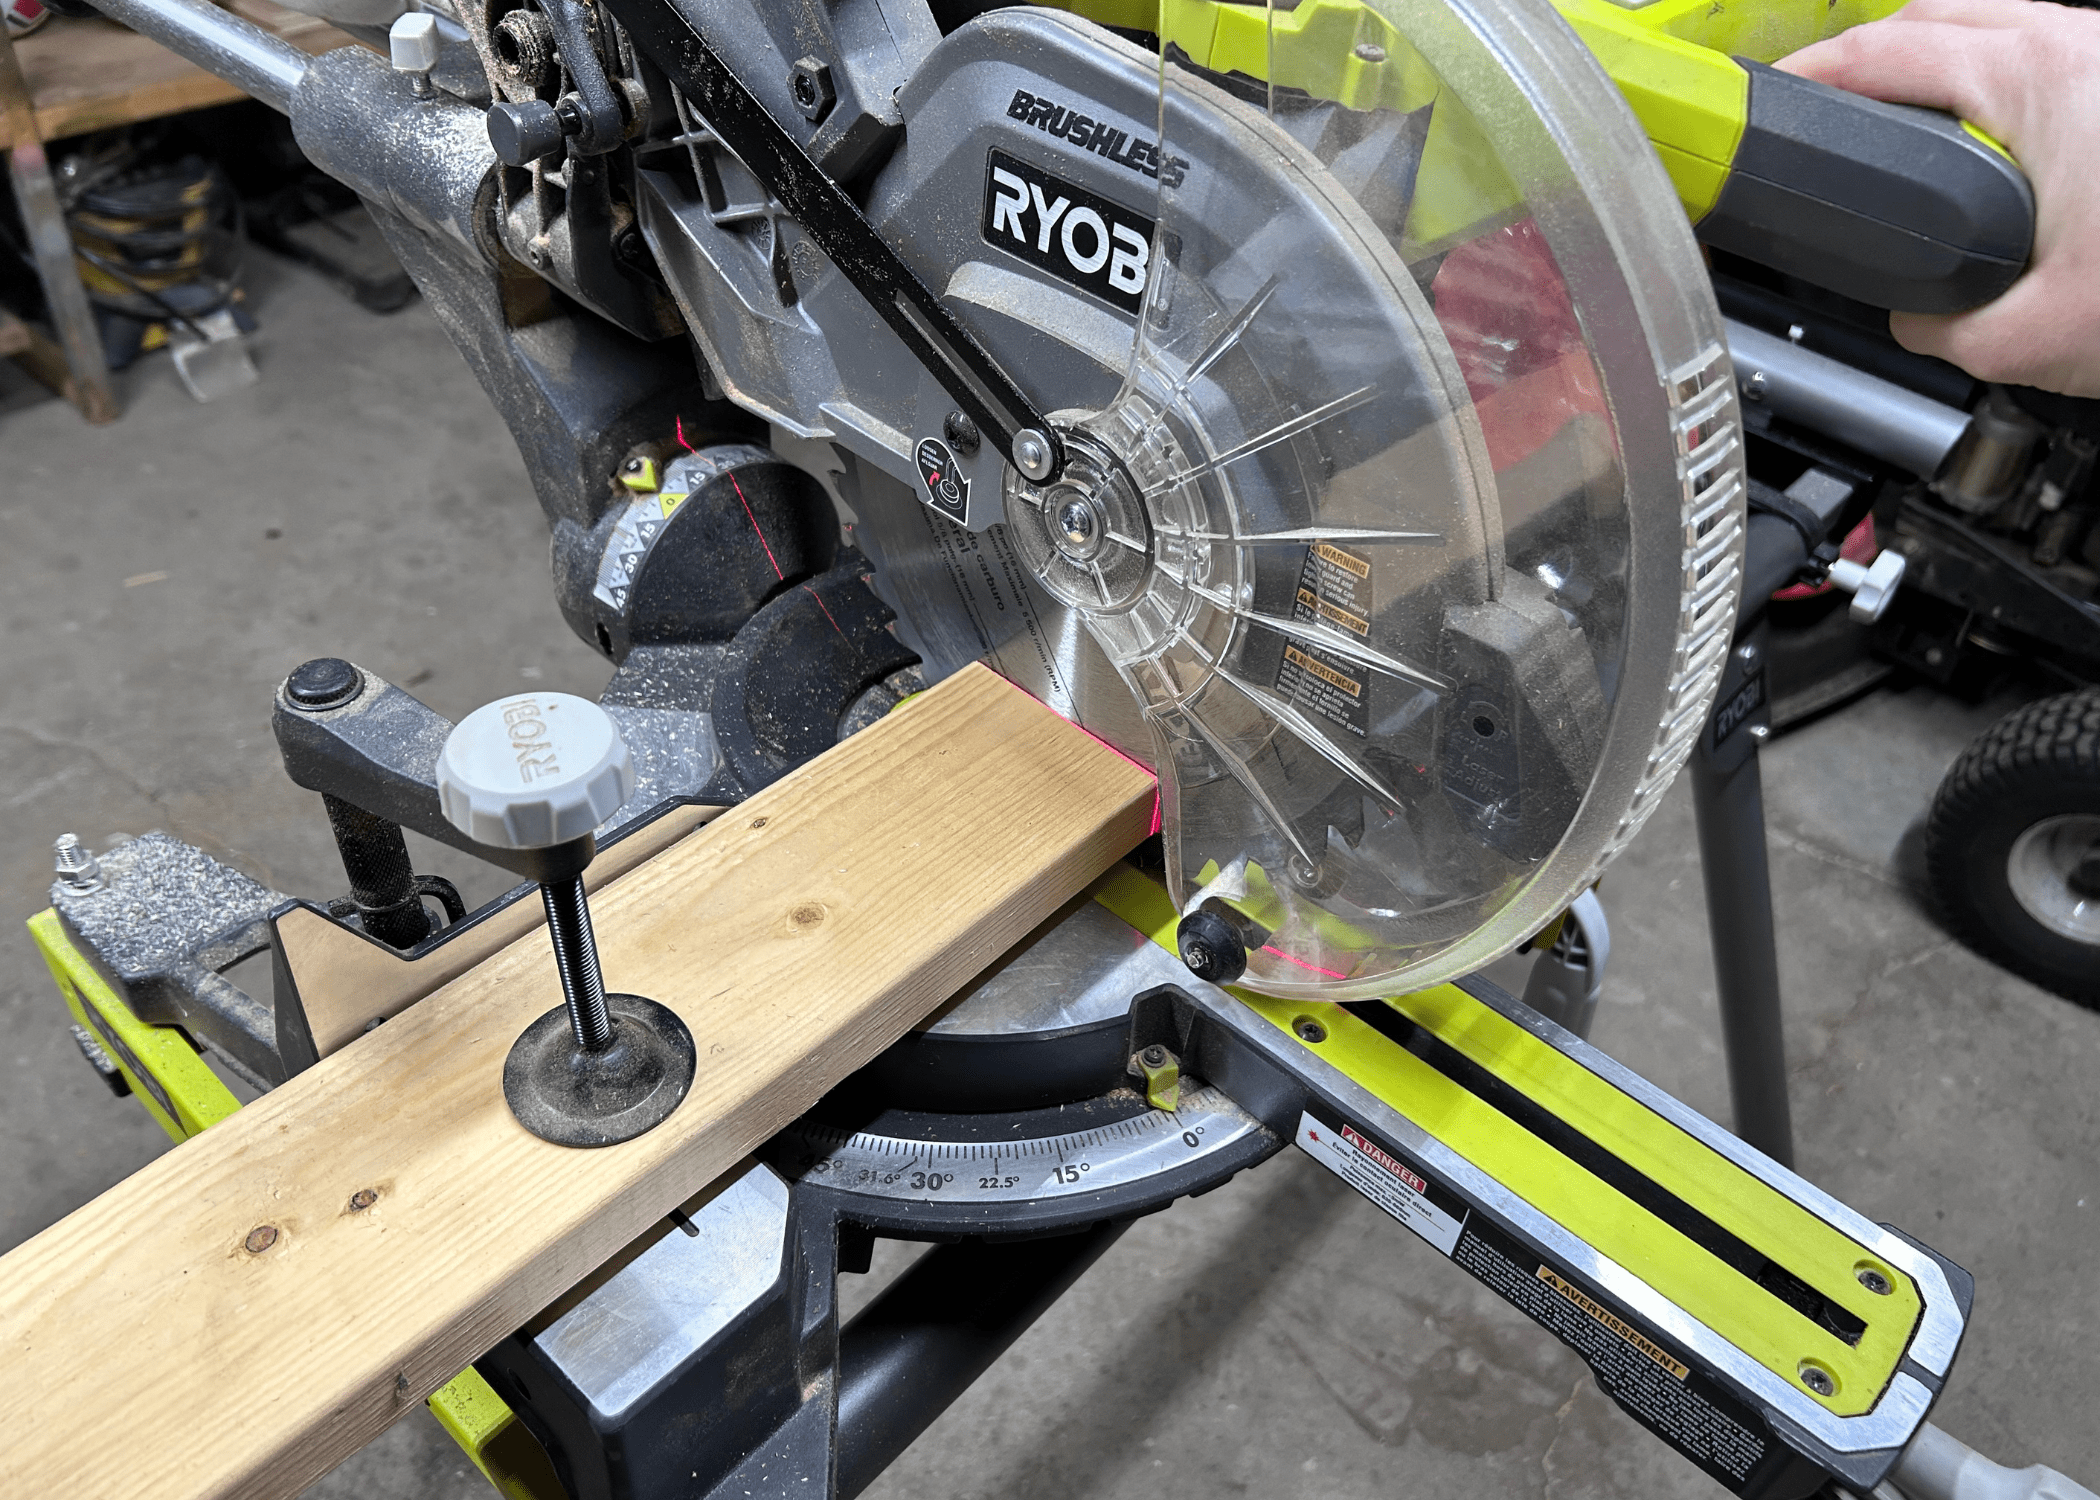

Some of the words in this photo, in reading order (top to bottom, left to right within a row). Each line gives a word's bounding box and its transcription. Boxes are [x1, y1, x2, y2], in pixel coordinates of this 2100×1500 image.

[1006, 89, 1190, 189] BRUSHLESS
[992, 166, 1150, 295] RYOB
[689, 471, 706, 486] 15
[665, 497, 676, 506] 0
[640, 523, 656, 539] 15
[623, 553, 638, 574] 30
[1321, 545, 1366, 576] WARNING
[1335, 567, 1358, 583] restore
[975, 552, 1007, 611] carburo
[1012, 567, 1027, 590] mm)
[1321, 568, 1340, 584] guard
[1340, 578, 1353, 590] and
[1323, 579, 1342, 593] screw
[1343, 589, 1355, 600] can
[615, 588, 626, 608] 45
[1325, 589, 1348, 606] serious
[1000, 561, 1024, 607] Maximale
[1025, 618, 1036, 636] 500
[1032, 636, 1048, 663] r/min
[1043, 663, 1061, 693] (RPM)
[500, 699, 560, 784] RYOBI
[859, 1169, 901, 1184] 31.6°
[910, 1172, 954, 1191] 30°
[978, 1175, 1019, 1190] 22.5°
[1051, 1162, 1091, 1185] 15°
[1182, 1126, 1206, 1149] 0°
[1351, 1148, 1396, 1184] Rayonnement
[1397, 1181, 1415, 1197] laser
[1362, 1141, 1420, 1189] DANGER
[1351, 1155, 1358, 1164] le
[1359, 1161, 1383, 1182] contact
[1383, 1179, 1411, 1202] oculaire
[1412, 1199, 1432, 1217] direct
[1560, 1284, 1682, 1373] AVERTISSEMENT
